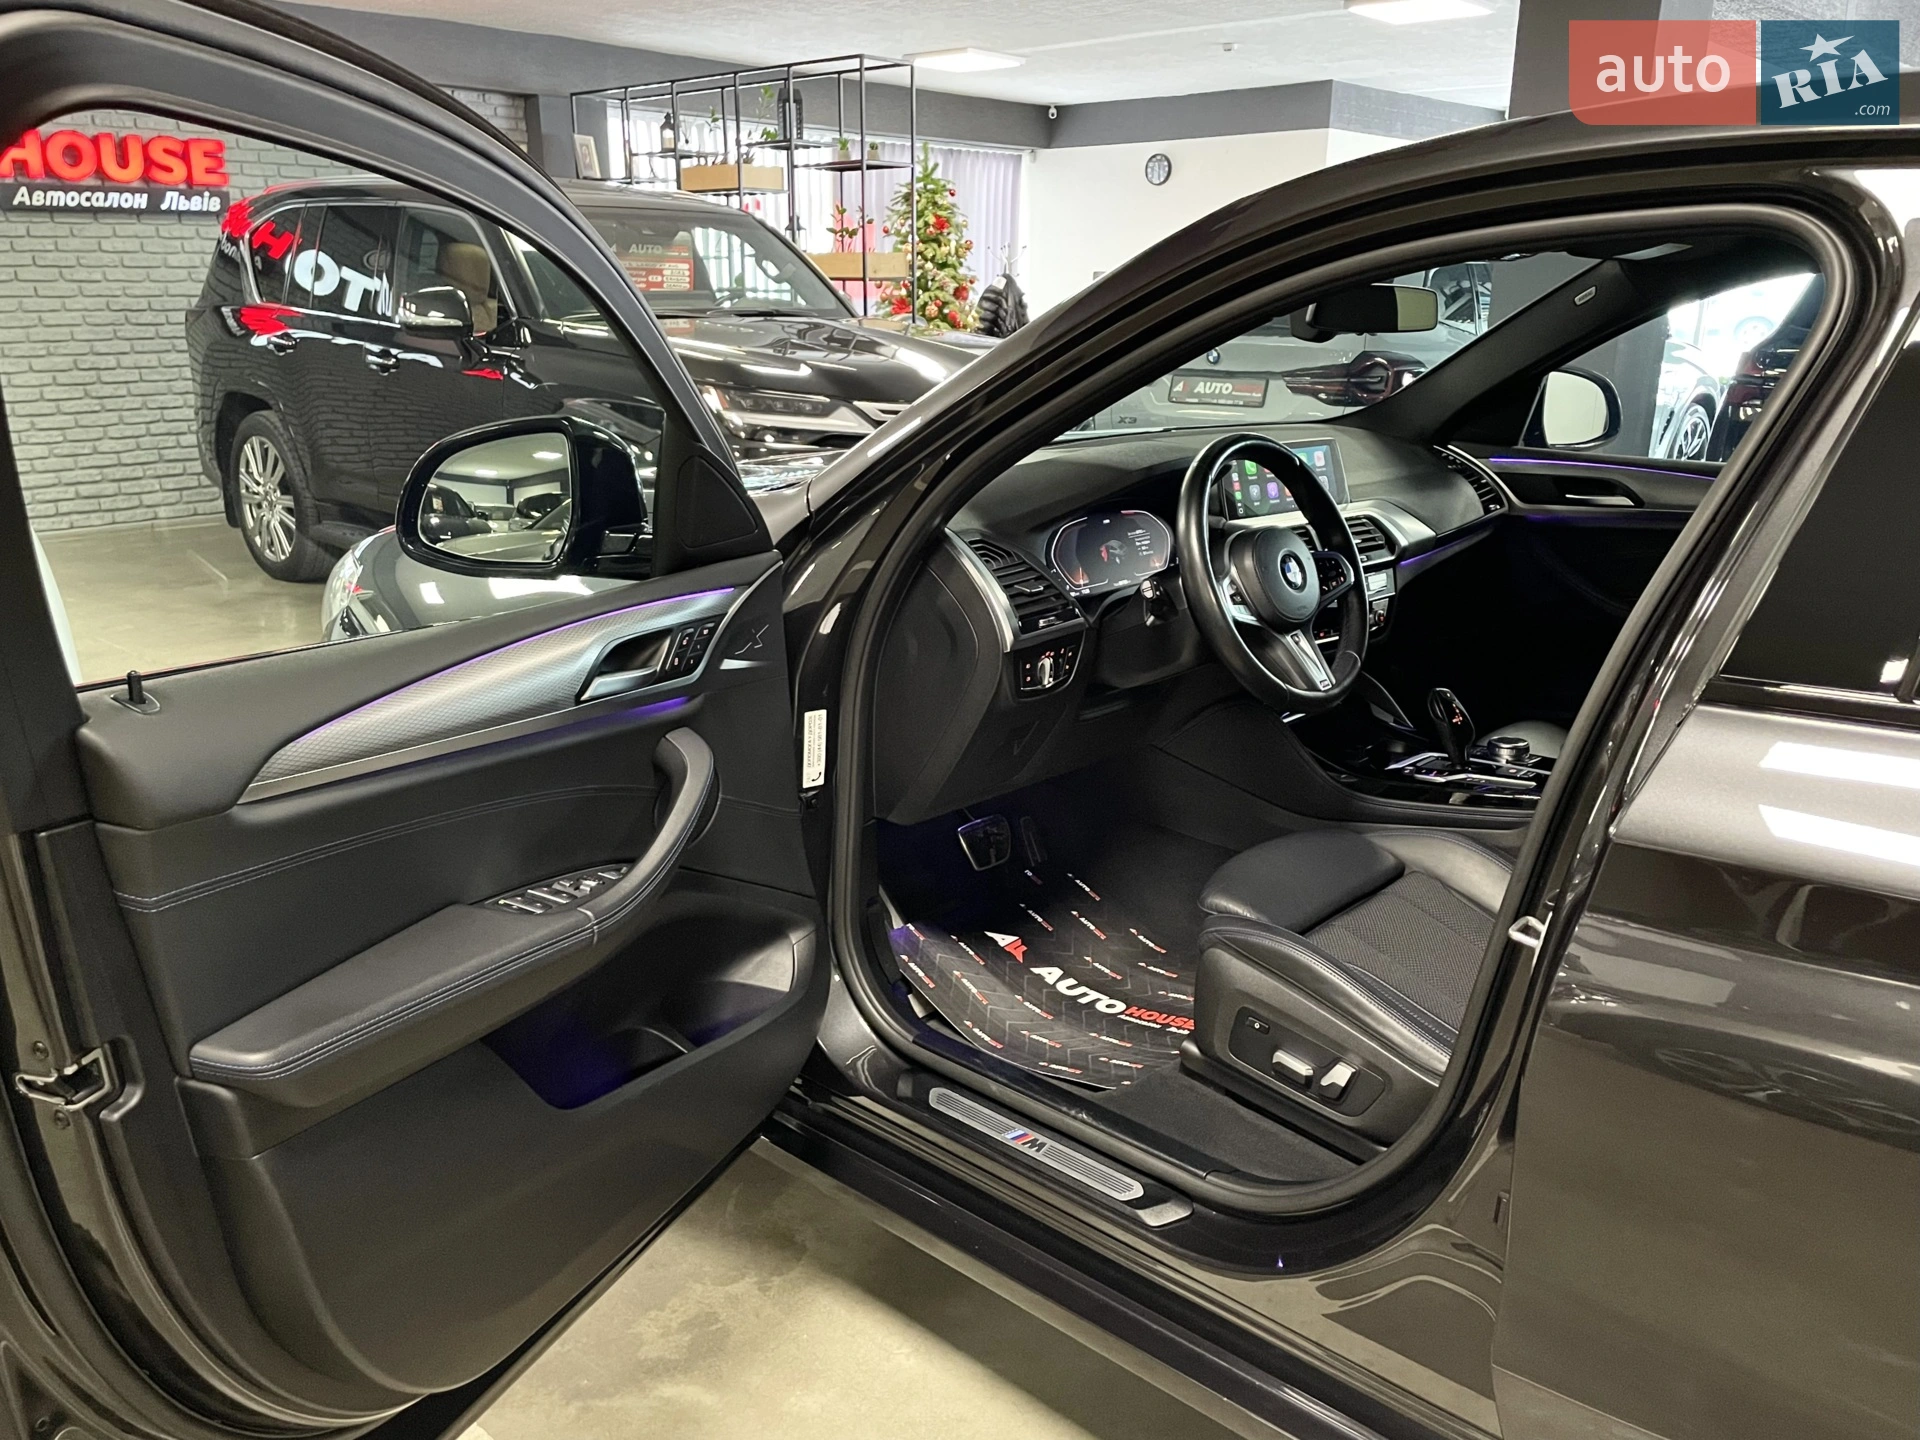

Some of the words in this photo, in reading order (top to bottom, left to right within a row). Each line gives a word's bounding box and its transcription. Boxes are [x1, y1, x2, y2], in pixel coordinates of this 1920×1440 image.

[0, 128, 229, 186] HOUSE
[12, 185, 149, 209] Автосалон
[160, 190, 222, 212] Львів
[629, 243, 663, 254] AUTO
[1193, 381, 1233, 394] AUTO
[1117, 415, 1137, 425] X3
[1030, 966, 1127, 1014] AUTO
[1124, 1006, 1195, 1031] HOUSE
